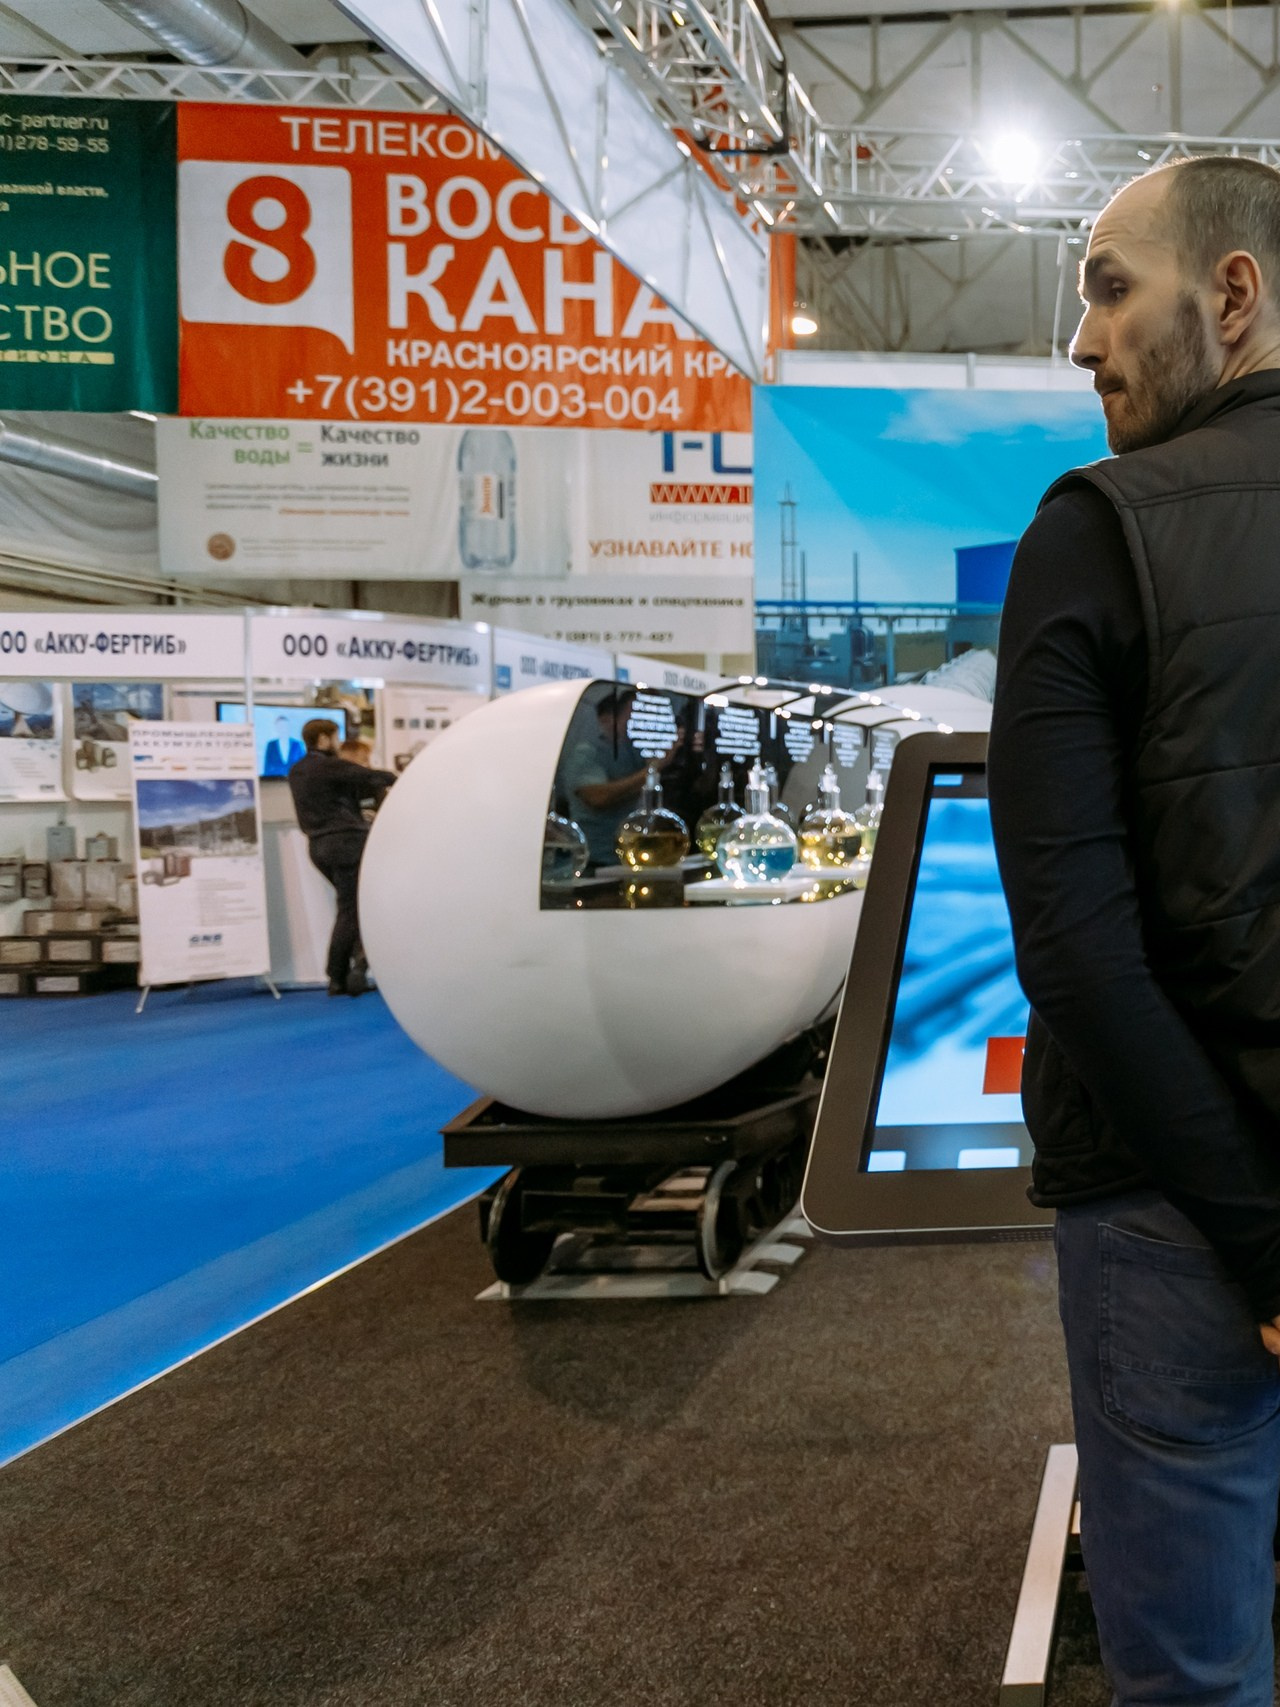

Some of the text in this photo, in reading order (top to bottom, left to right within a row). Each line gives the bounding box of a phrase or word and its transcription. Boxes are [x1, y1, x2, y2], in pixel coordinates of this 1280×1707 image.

[223, 175, 317, 306] 8
[386, 242, 708, 341] КАНА
[386, 340, 673, 377] КРАСНОЯРСКИЙ
[286, 374, 682, 423] +7(391)2-003-004
[190, 420, 290, 440] Качество
[320, 425, 421, 445] Качество
[234, 447, 290, 467] воды
[321, 451, 389, 468] жизни
[589, 537, 721, 559] УЗНАВАЙТЕ
[283, 634, 329, 656] ООО
